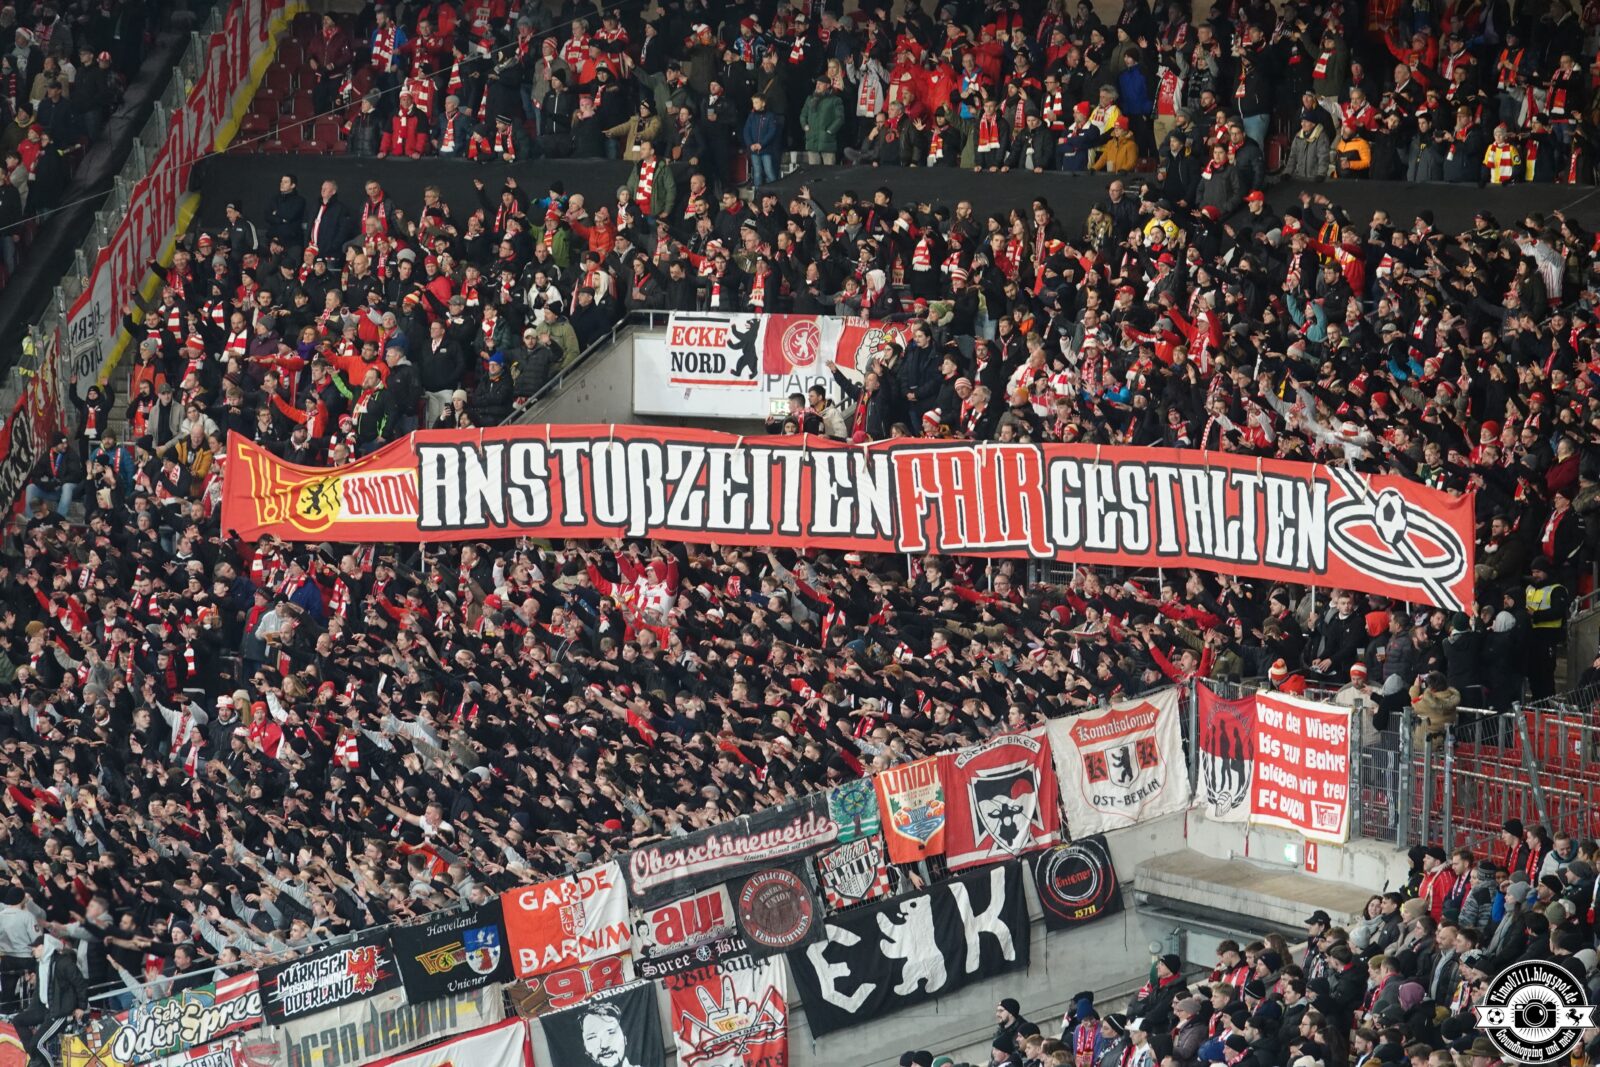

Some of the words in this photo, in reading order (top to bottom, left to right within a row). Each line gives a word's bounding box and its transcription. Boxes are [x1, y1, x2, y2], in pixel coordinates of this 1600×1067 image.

[671, 325, 728, 348] ECKE
[671, 351, 726, 374] NORD
[342, 473, 419, 516] UNION
[893, 443, 1055, 557] FAIR
[1050, 460, 1328, 573] GESTALTEN
[1007, 735, 1038, 751] BIKER
[1305, 717, 1346, 745] Wiege
[1258, 732, 1280, 758] bis
[1305, 748, 1346, 773] Bahre
[1093, 778, 1161, 806] OST-BERLIN
[1258, 788, 1278, 810] FC
[1299, 776, 1318, 796] wir
[1323, 780, 1346, 800] treu
[631, 811, 829, 885] Oberschöneweide
[1307, 844, 1316, 871] 4
[518, 869, 614, 911] GARDE
[743, 885, 754, 902] DIE
[751, 871, 797, 887] ÜBLICHEN
[764, 890, 792, 908] UNION
[948, 865, 1016, 974] K
[519, 920, 632, 974] BARNIM
[642, 954, 691, 977] Spree
[715, 937, 747, 956] Blu
[278, 950, 347, 994] MÄRKISCH
[447, 975, 488, 992] Unioner
[284, 975, 354, 1016] ODERLAND
[113, 1019, 179, 1062] Oder
[181, 992, 263, 1044] Spree
